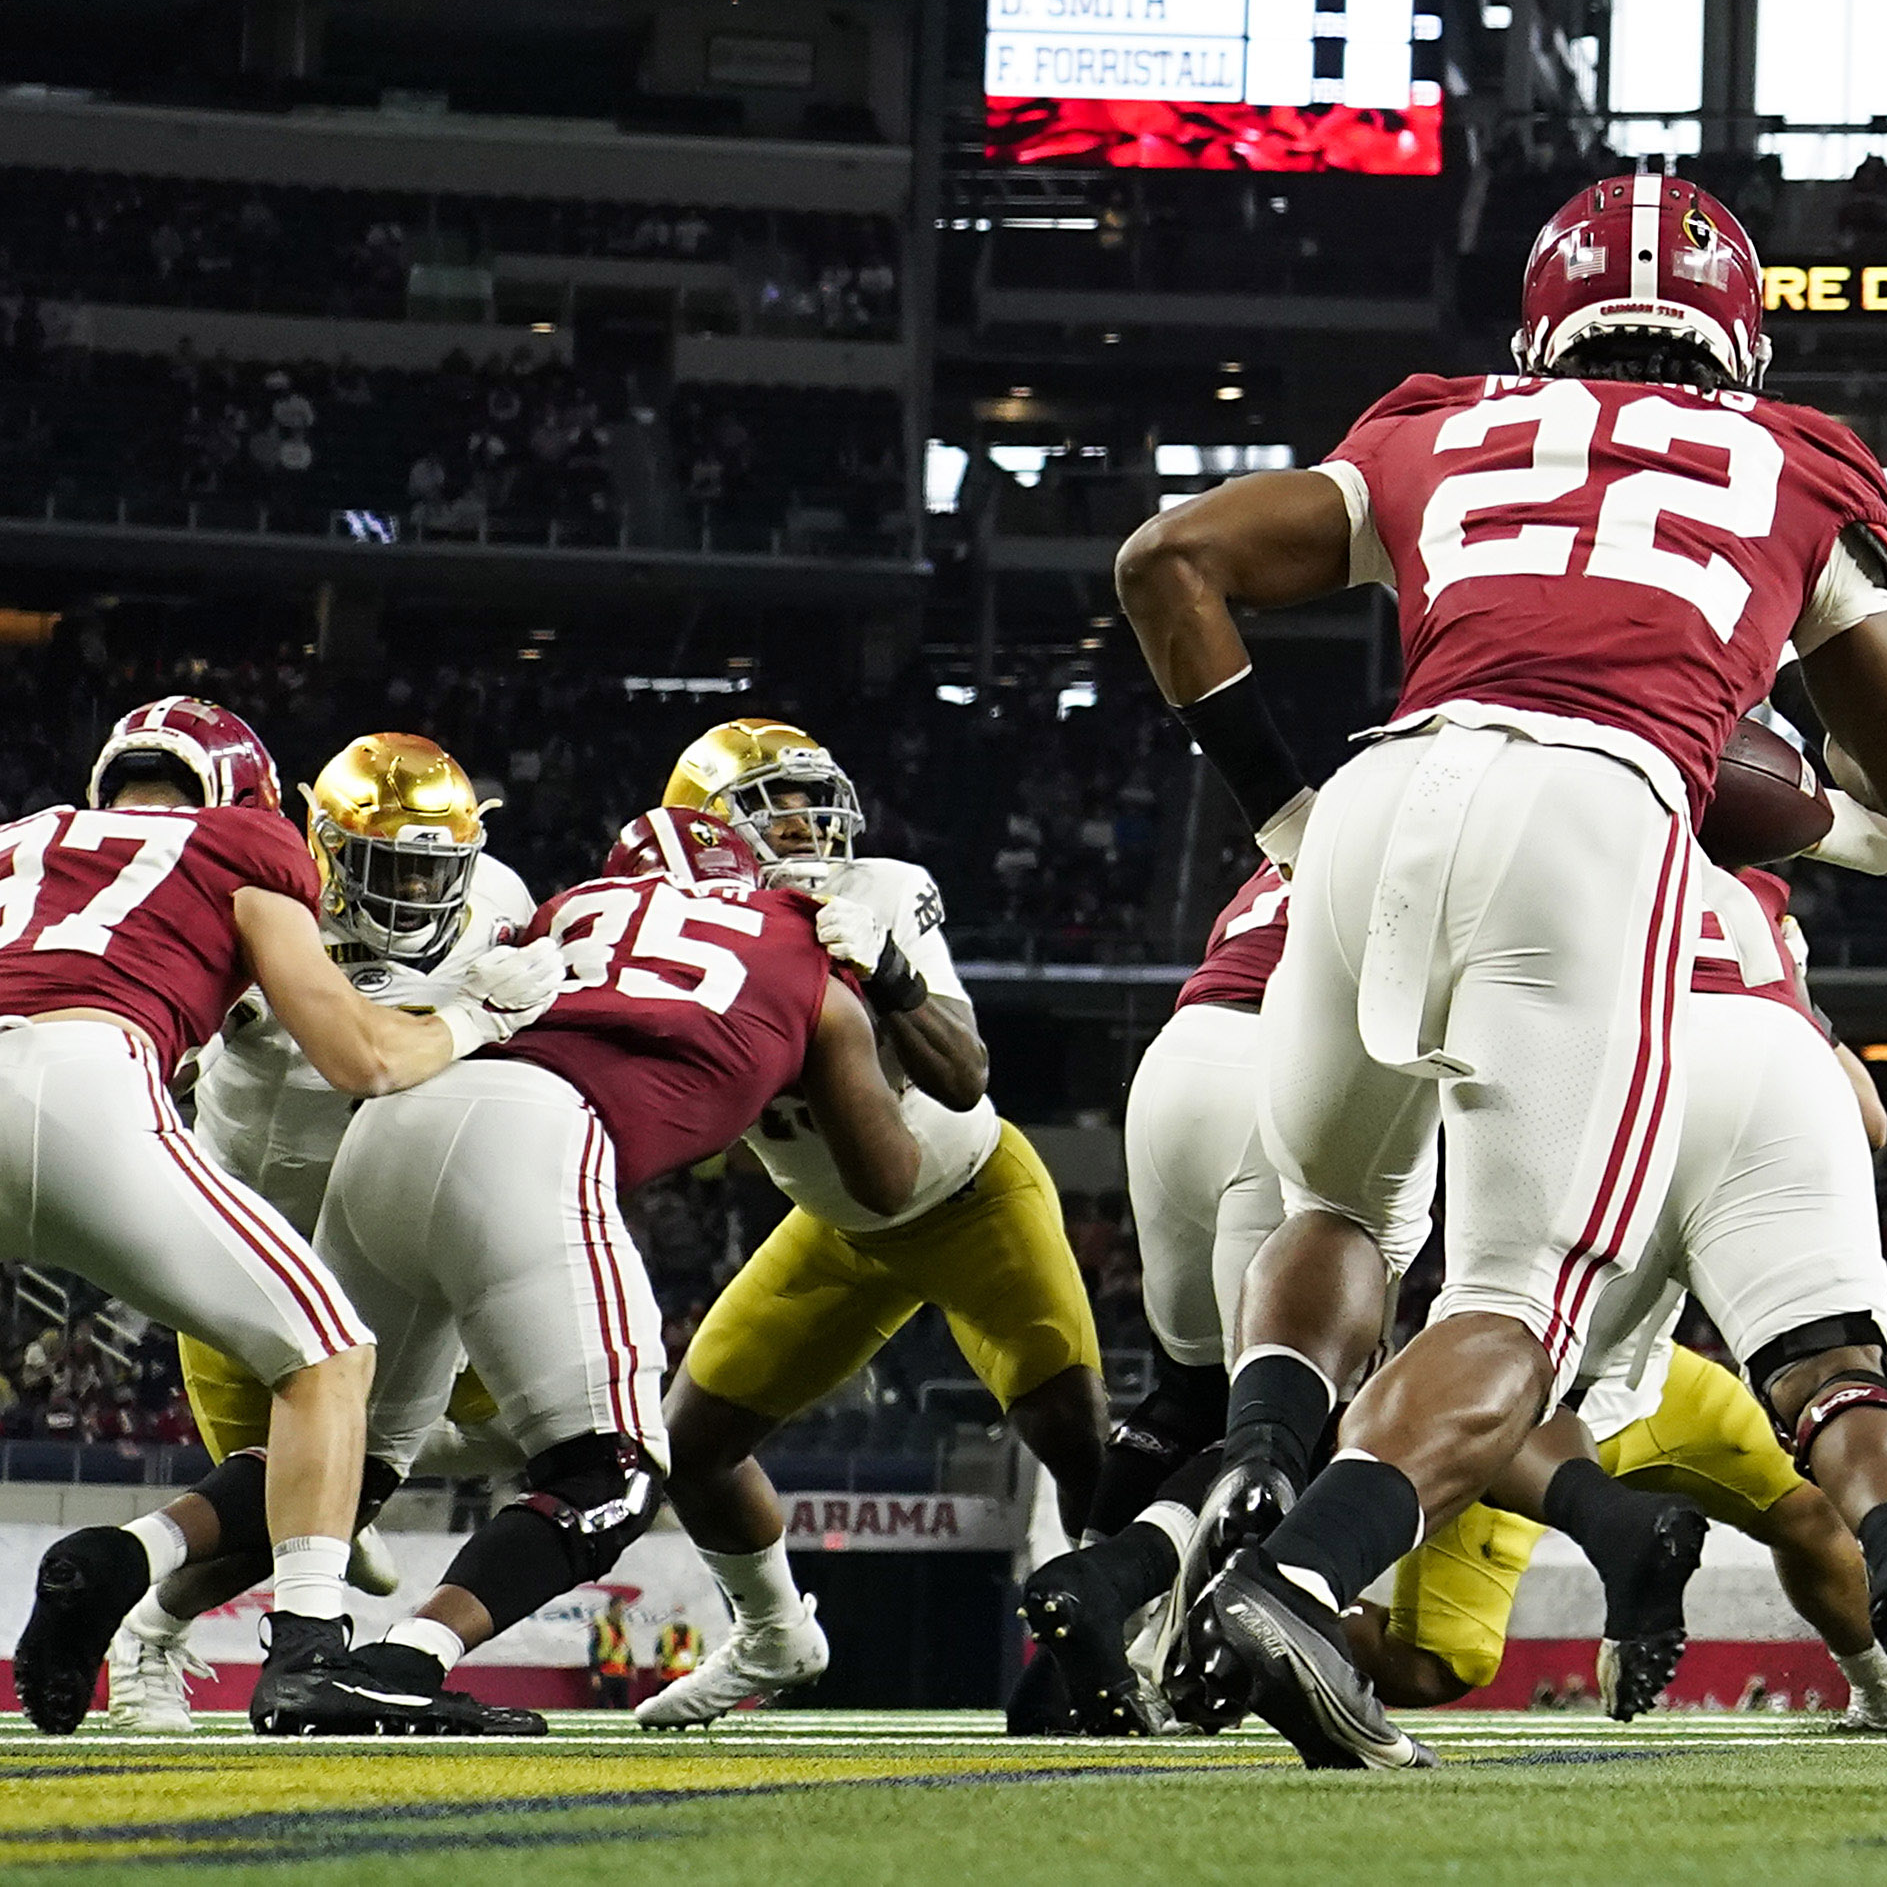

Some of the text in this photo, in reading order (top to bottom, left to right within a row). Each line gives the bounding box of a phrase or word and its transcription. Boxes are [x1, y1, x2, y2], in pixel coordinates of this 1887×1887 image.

[1035, 48, 1234, 91] FORRISTALL
[1416, 377, 1788, 645] 22
[549, 882, 765, 1015] 85
[787, 1500, 961, 1536] ABAMA
